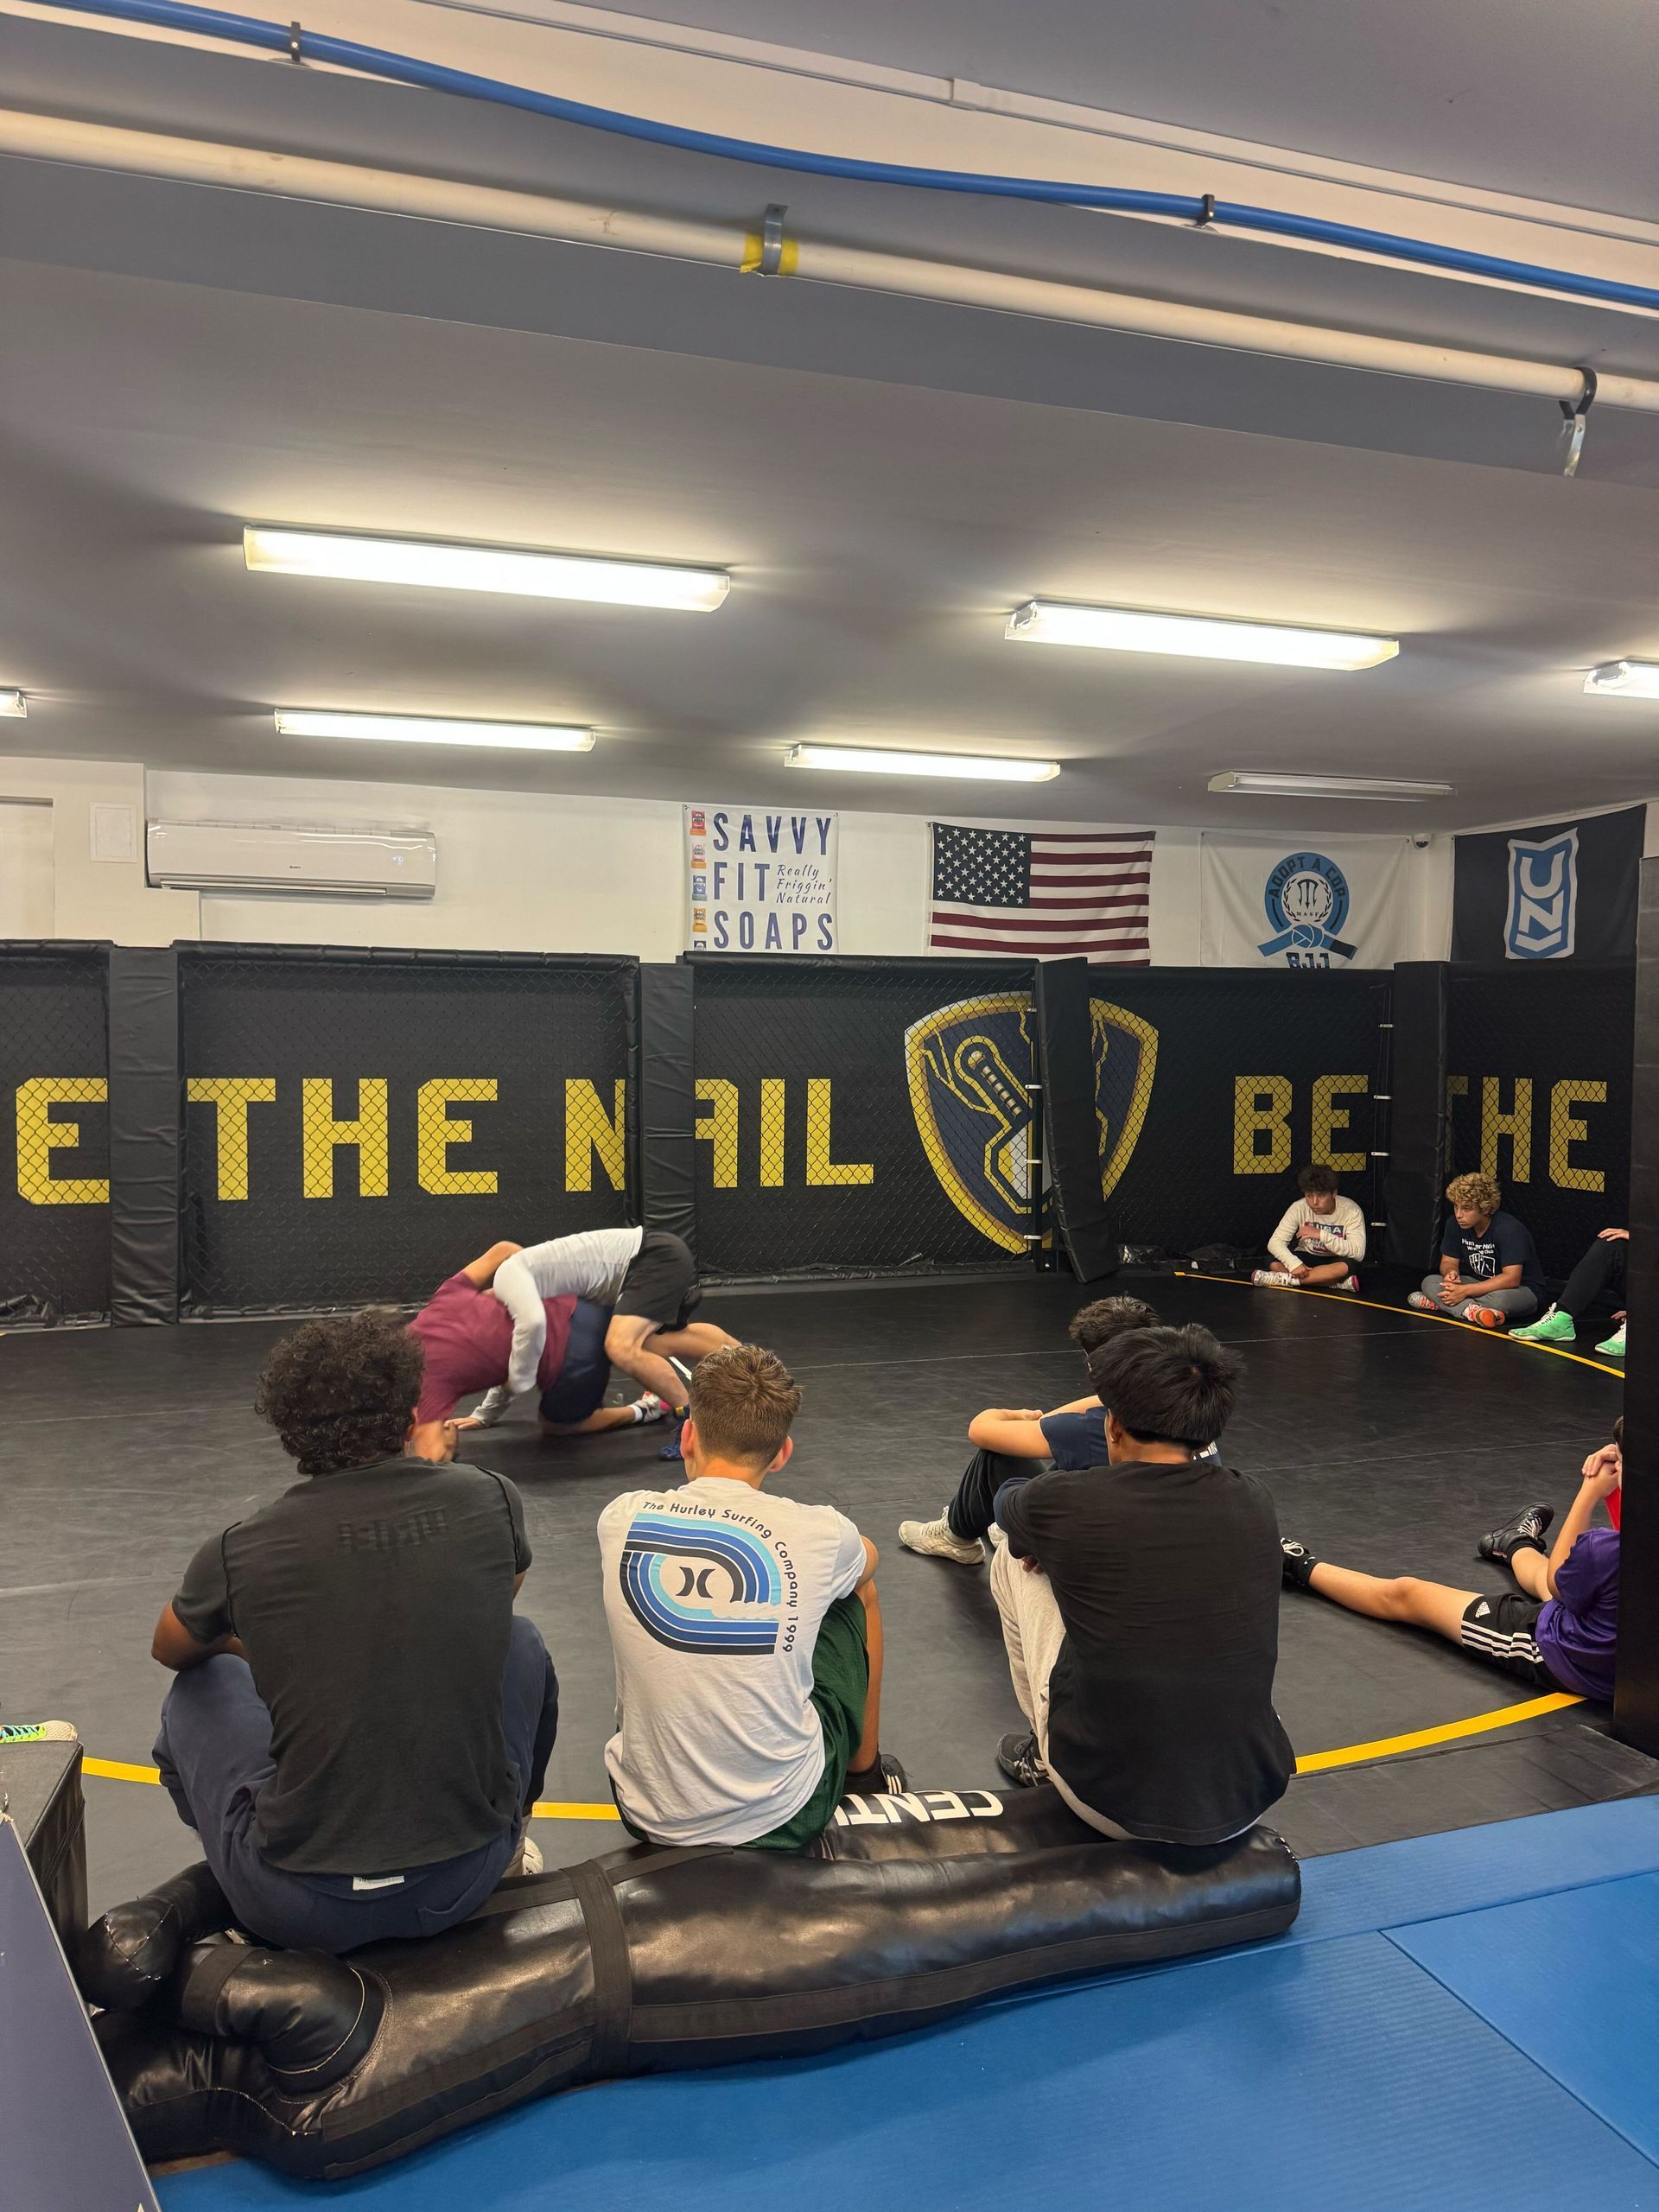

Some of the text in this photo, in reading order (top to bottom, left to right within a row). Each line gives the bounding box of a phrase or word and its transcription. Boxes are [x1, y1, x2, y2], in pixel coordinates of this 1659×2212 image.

[713, 812, 831, 855] SAVVY
[714, 861, 771, 901] FIT
[777, 878, 832, 894] Friggin'
[778, 864, 819, 880] Really
[1268, 856, 1346, 899] ADOPT A COP
[776, 892, 831, 904] Natural
[713, 910, 833, 950] SOAPS
[187, 1077, 498, 1200] THE
[1233, 1074, 1369, 1174] BE
[643, 1501, 799, 1653] The Hurley Surfing Company 1999
